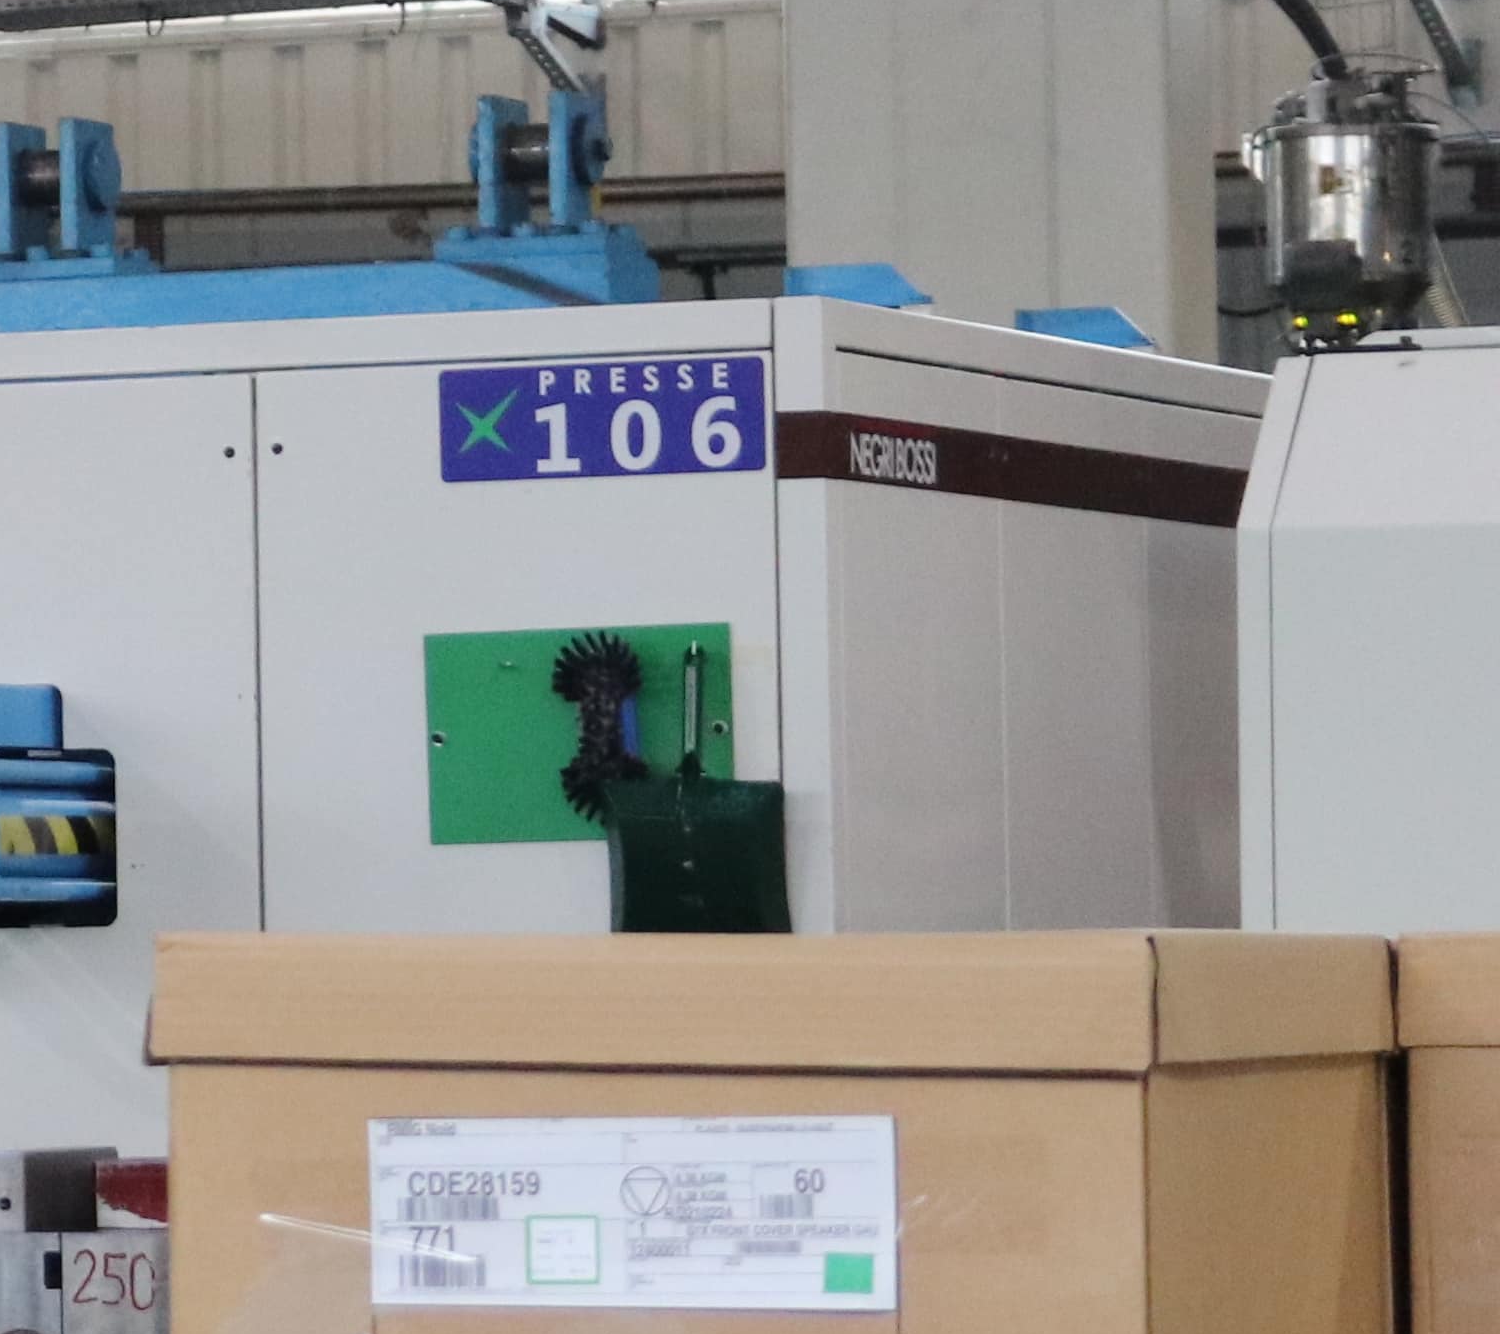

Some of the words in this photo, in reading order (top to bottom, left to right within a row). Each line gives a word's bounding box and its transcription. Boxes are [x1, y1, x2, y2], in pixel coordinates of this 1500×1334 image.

[538, 362, 730, 396] PRESSE
[534, 396, 741, 473] 106
[850, 431, 895, 479] NEGRI
[896, 437, 937, 485] BOSSI
[407, 1171, 541, 1197] CDE28159
[793, 1168, 826, 1194] 60
[409, 1225, 455, 1252] 771
[73, 1249, 155, 1310] 250
